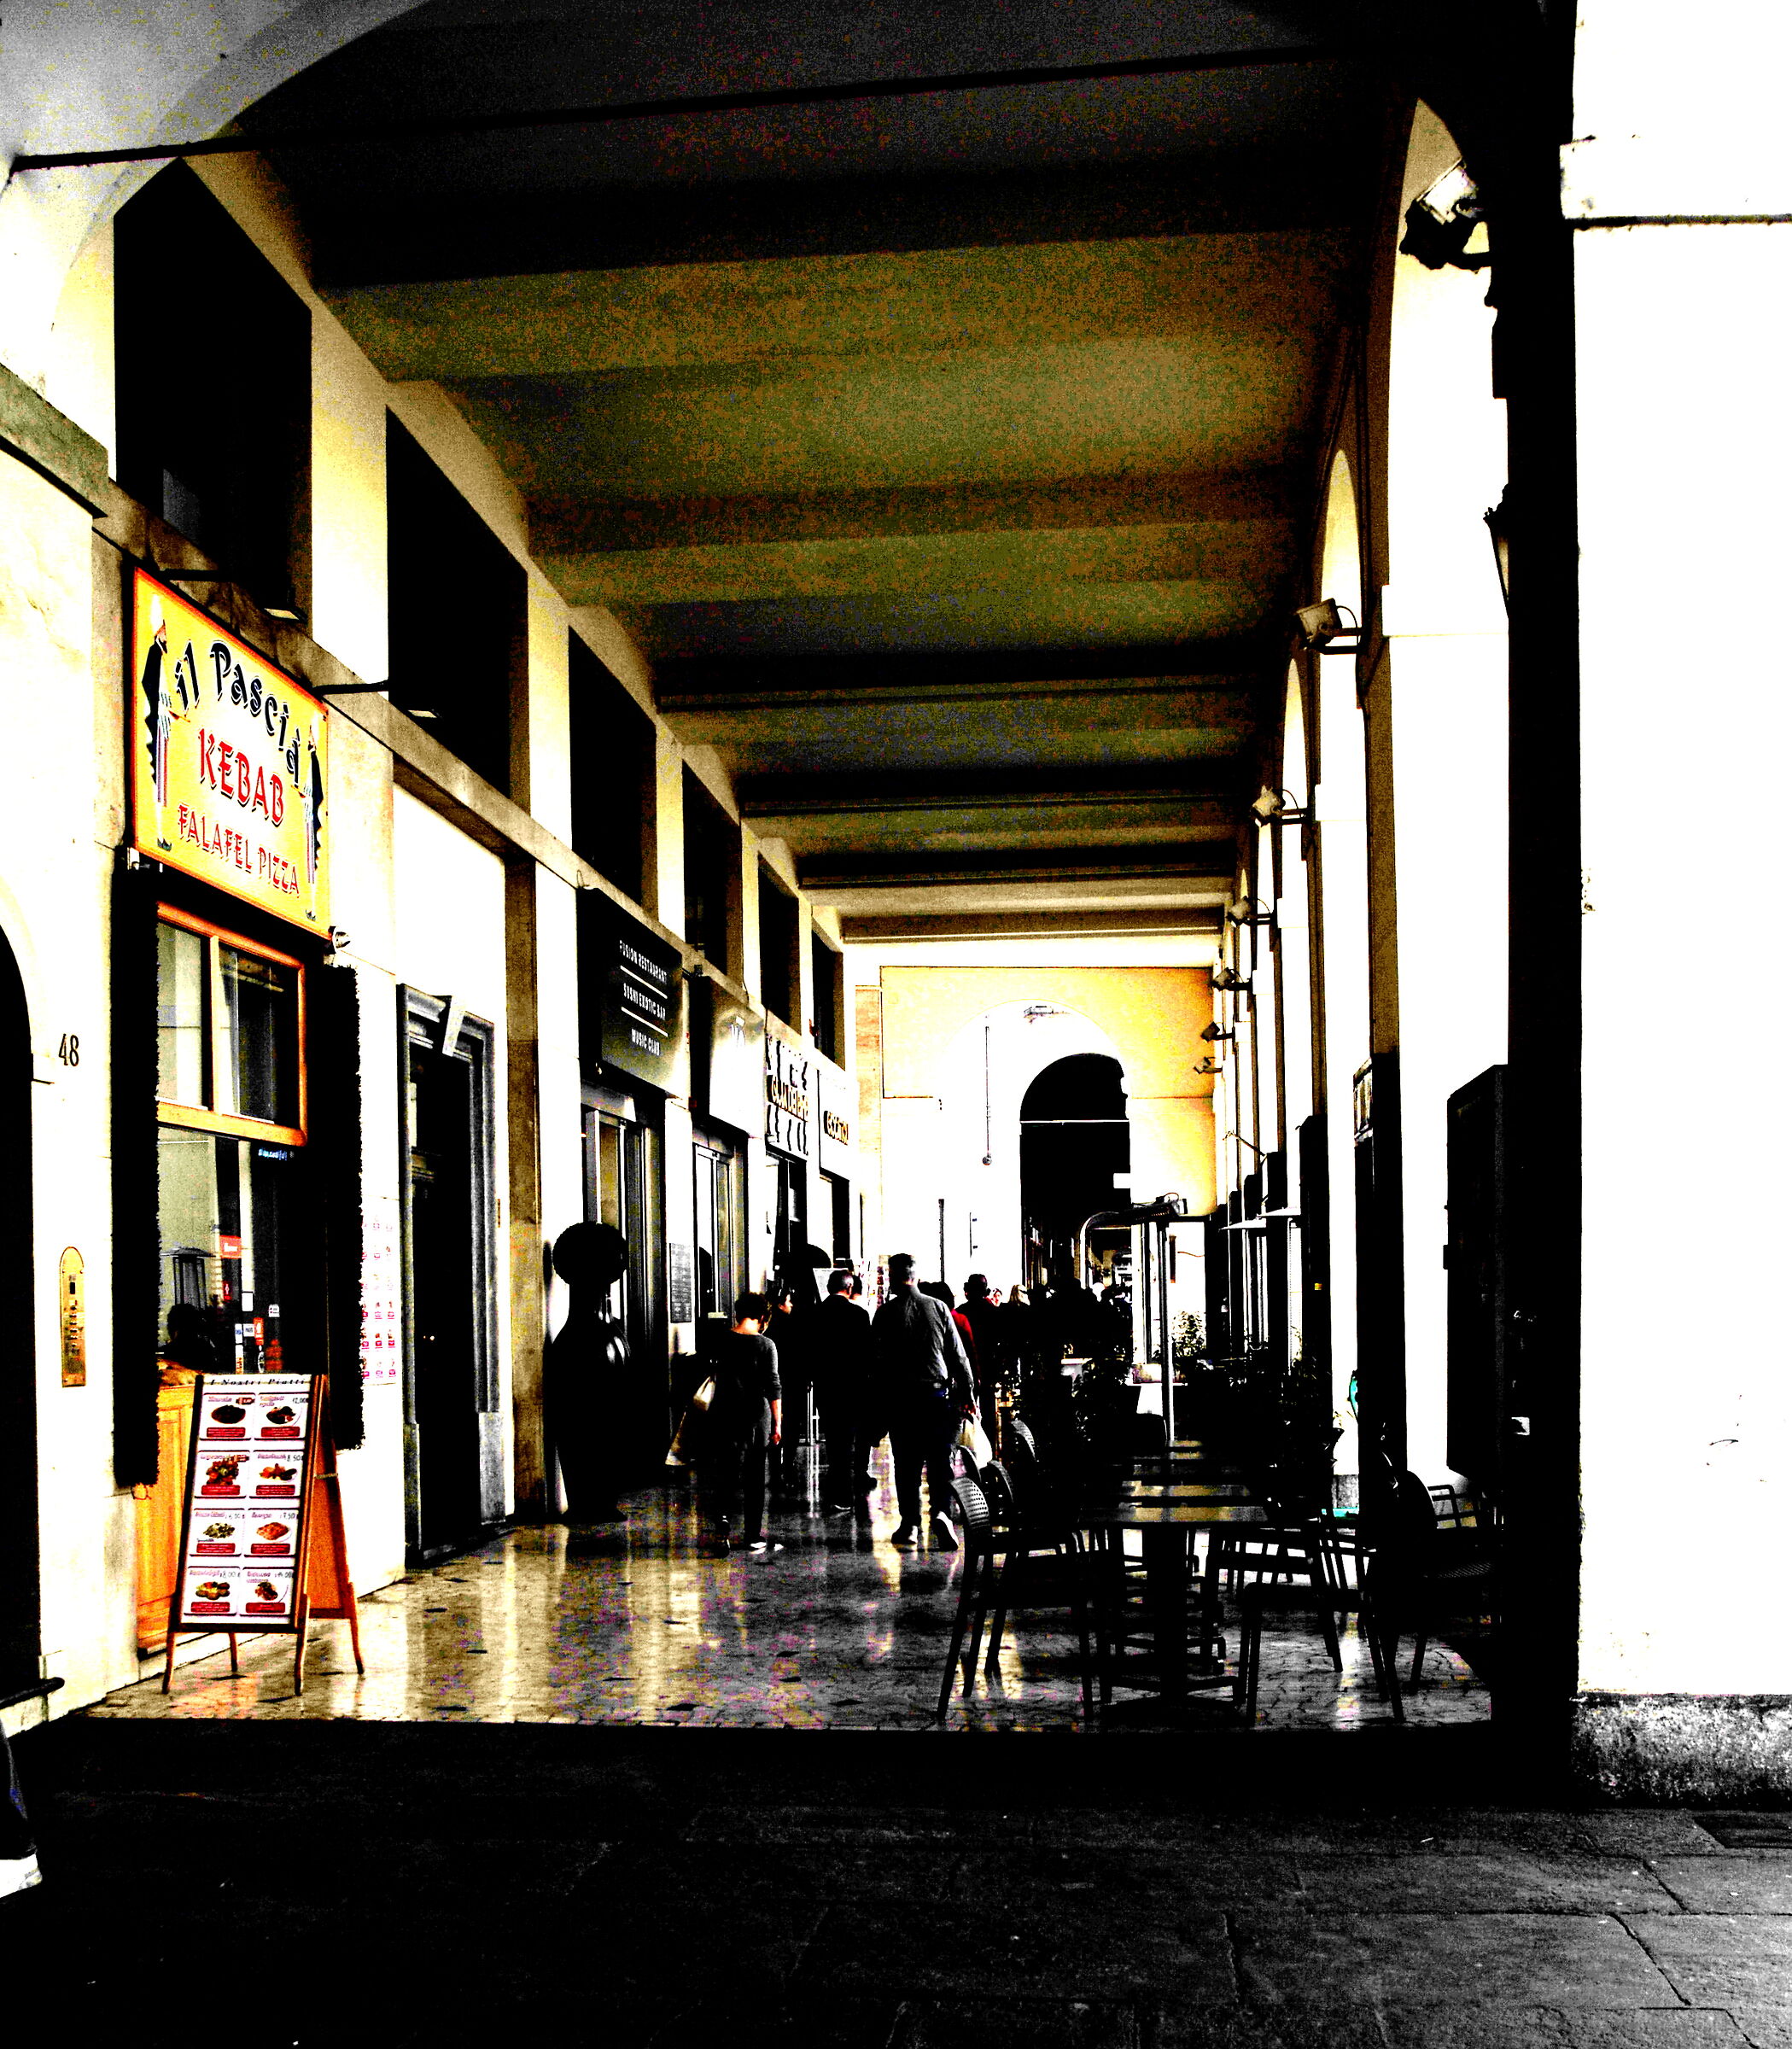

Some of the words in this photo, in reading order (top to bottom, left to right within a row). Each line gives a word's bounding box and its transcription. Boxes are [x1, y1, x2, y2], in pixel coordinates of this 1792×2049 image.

[173, 641, 201, 715] il
[198, 728, 285, 826] KEBAB
[178, 804, 253, 874] FALAFEL
[259, 846, 301, 898] PIZZA
[619, 939, 638, 965] FUSION
[639, 953, 667, 984] RESTAURANT
[623, 983, 639, 1005] SUSHI
[639, 992, 657, 1016] EXOTIC
[657, 1003, 666, 1021] BAR
[58, 1033, 79, 1065] 48
[632, 1028, 647, 1049] MUSIC
[649, 1037, 660, 1056] CLUB
